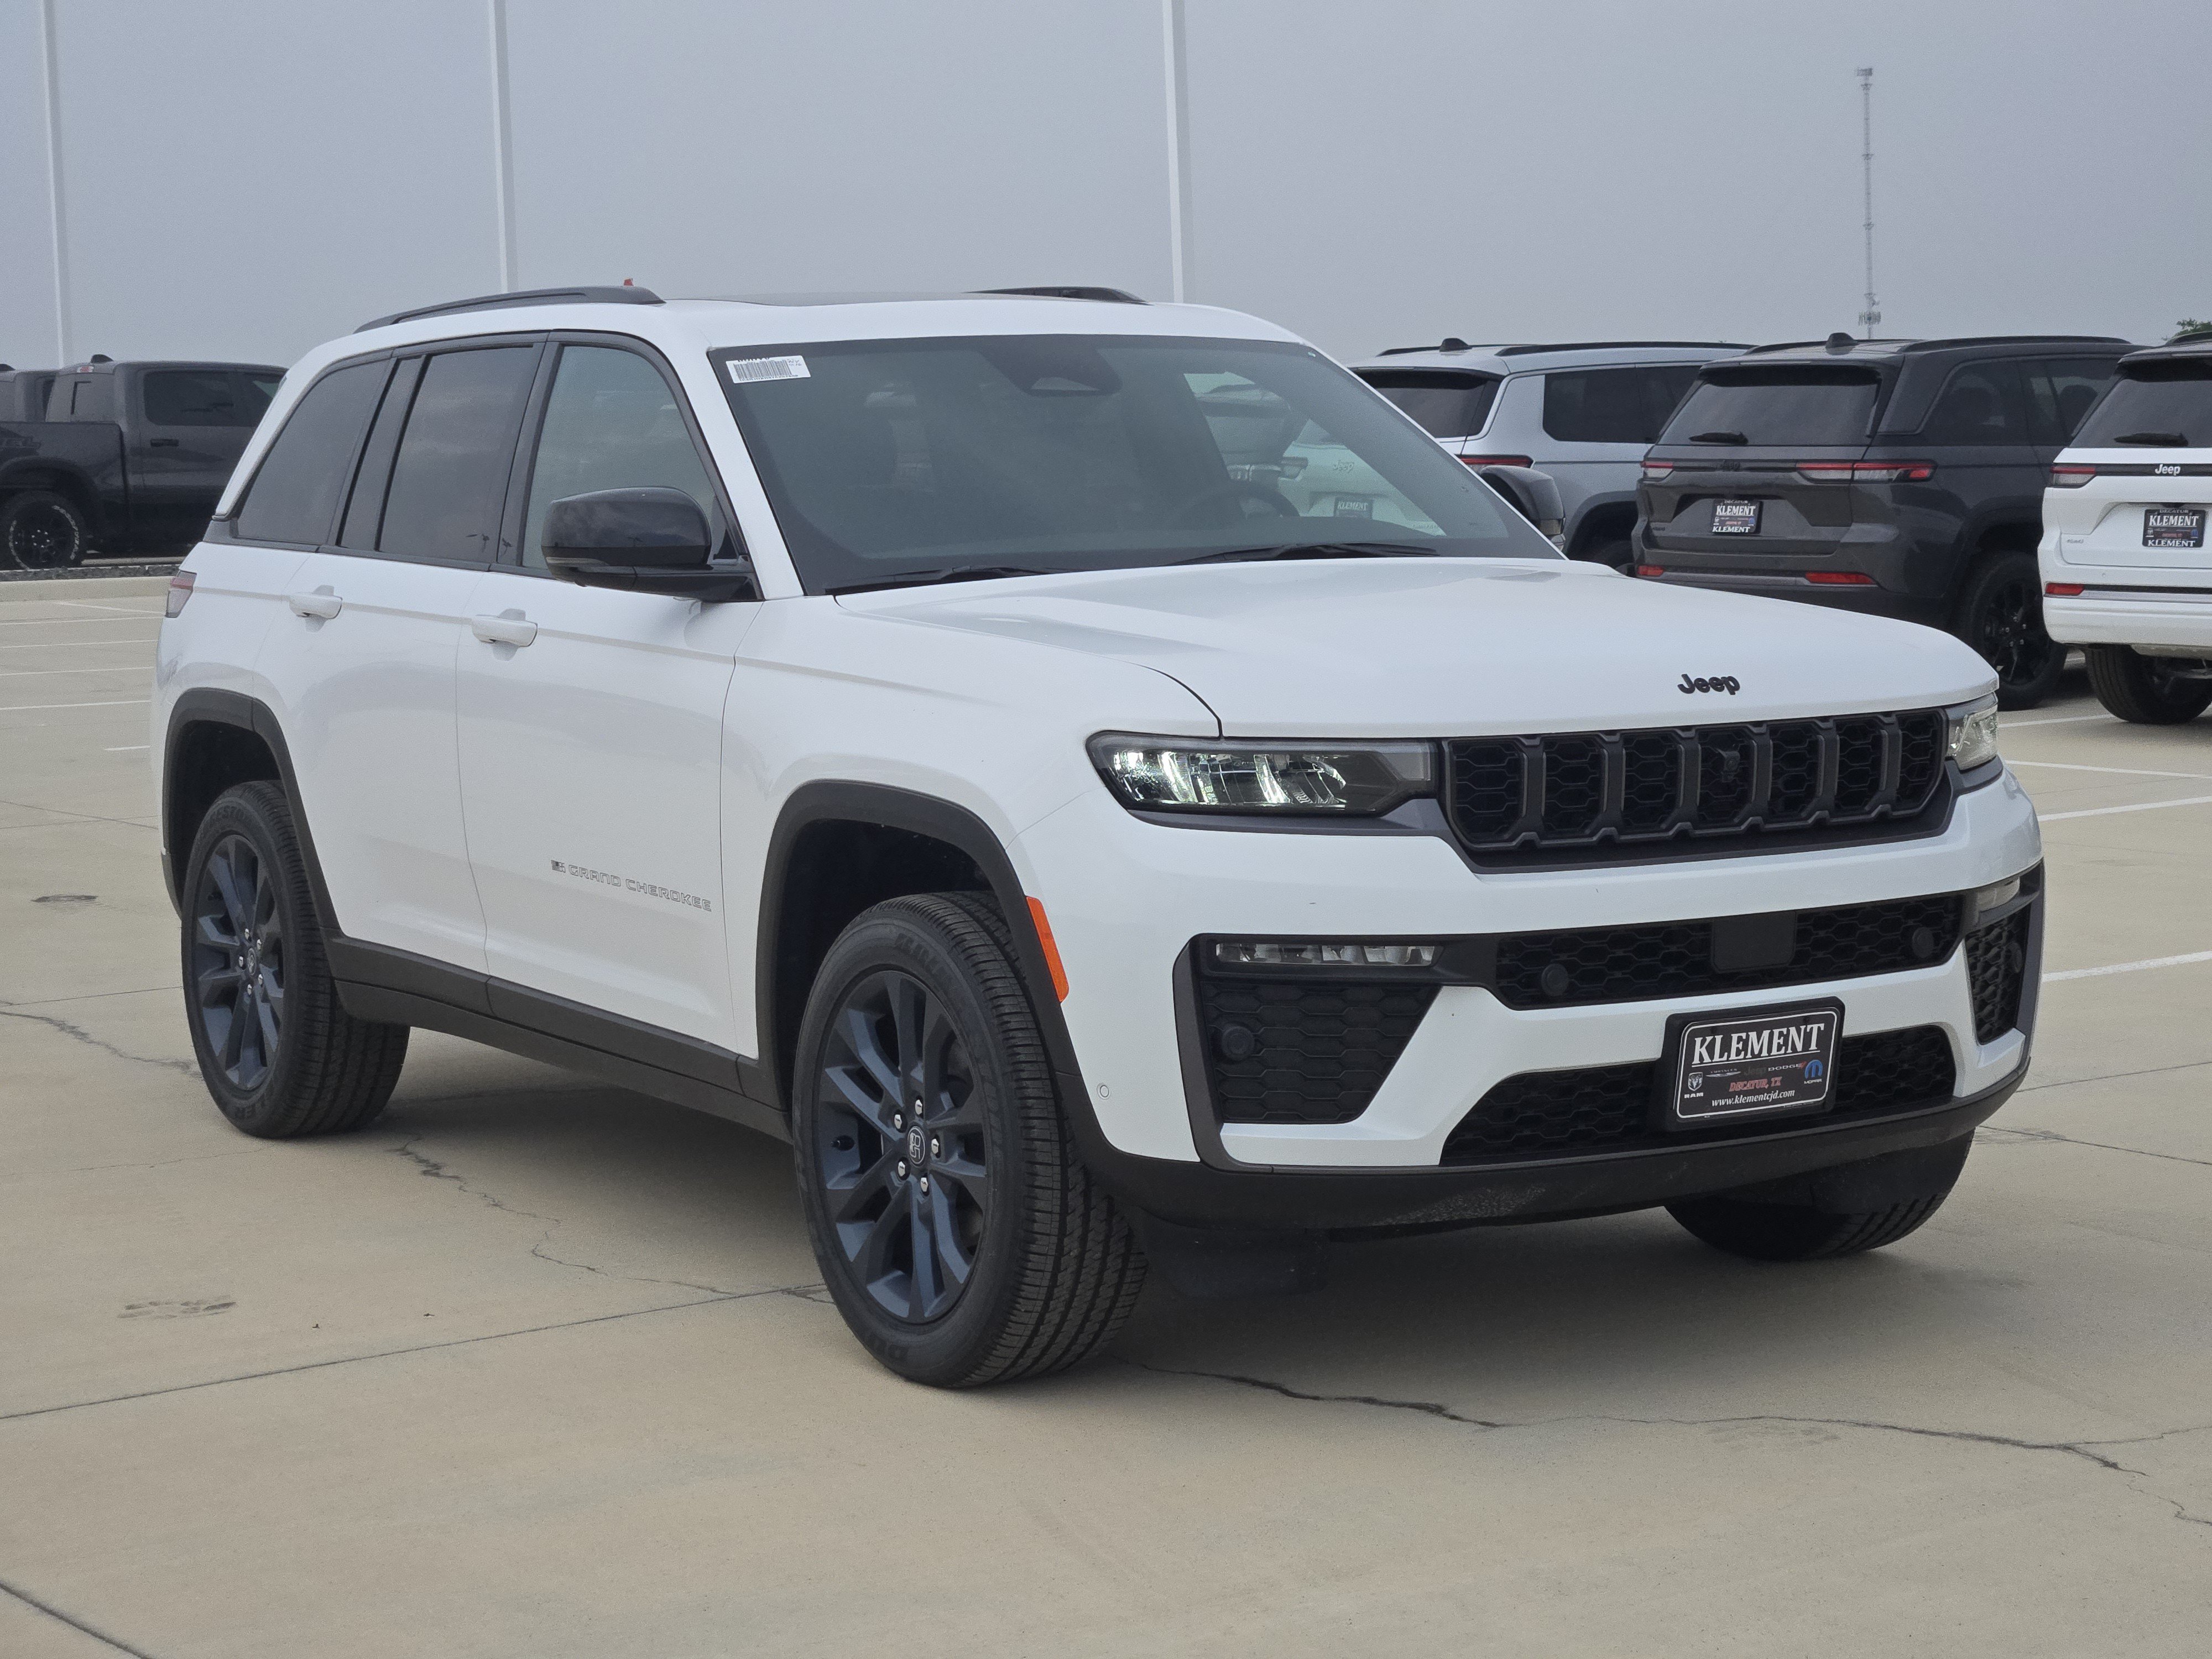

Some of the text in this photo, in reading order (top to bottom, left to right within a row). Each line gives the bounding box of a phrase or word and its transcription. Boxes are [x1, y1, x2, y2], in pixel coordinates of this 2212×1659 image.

[2155, 464, 2180, 476] Jeep
[1337, 501, 1368, 511] KLEMENT
[1716, 505, 1756, 515] KLEMENT
[2149, 515, 2199, 526] KLEMENT
[1677, 674, 1740, 695] Jeep
[568, 864, 712, 912] GRAND CHEROKEE
[1692, 1023, 1825, 1065] KLEMENT
[1768, 1063, 1801, 1072] DODGE
[1771, 1076, 1782, 1087] TX
[1712, 1090, 1796, 1106] www.klementcjd.com
